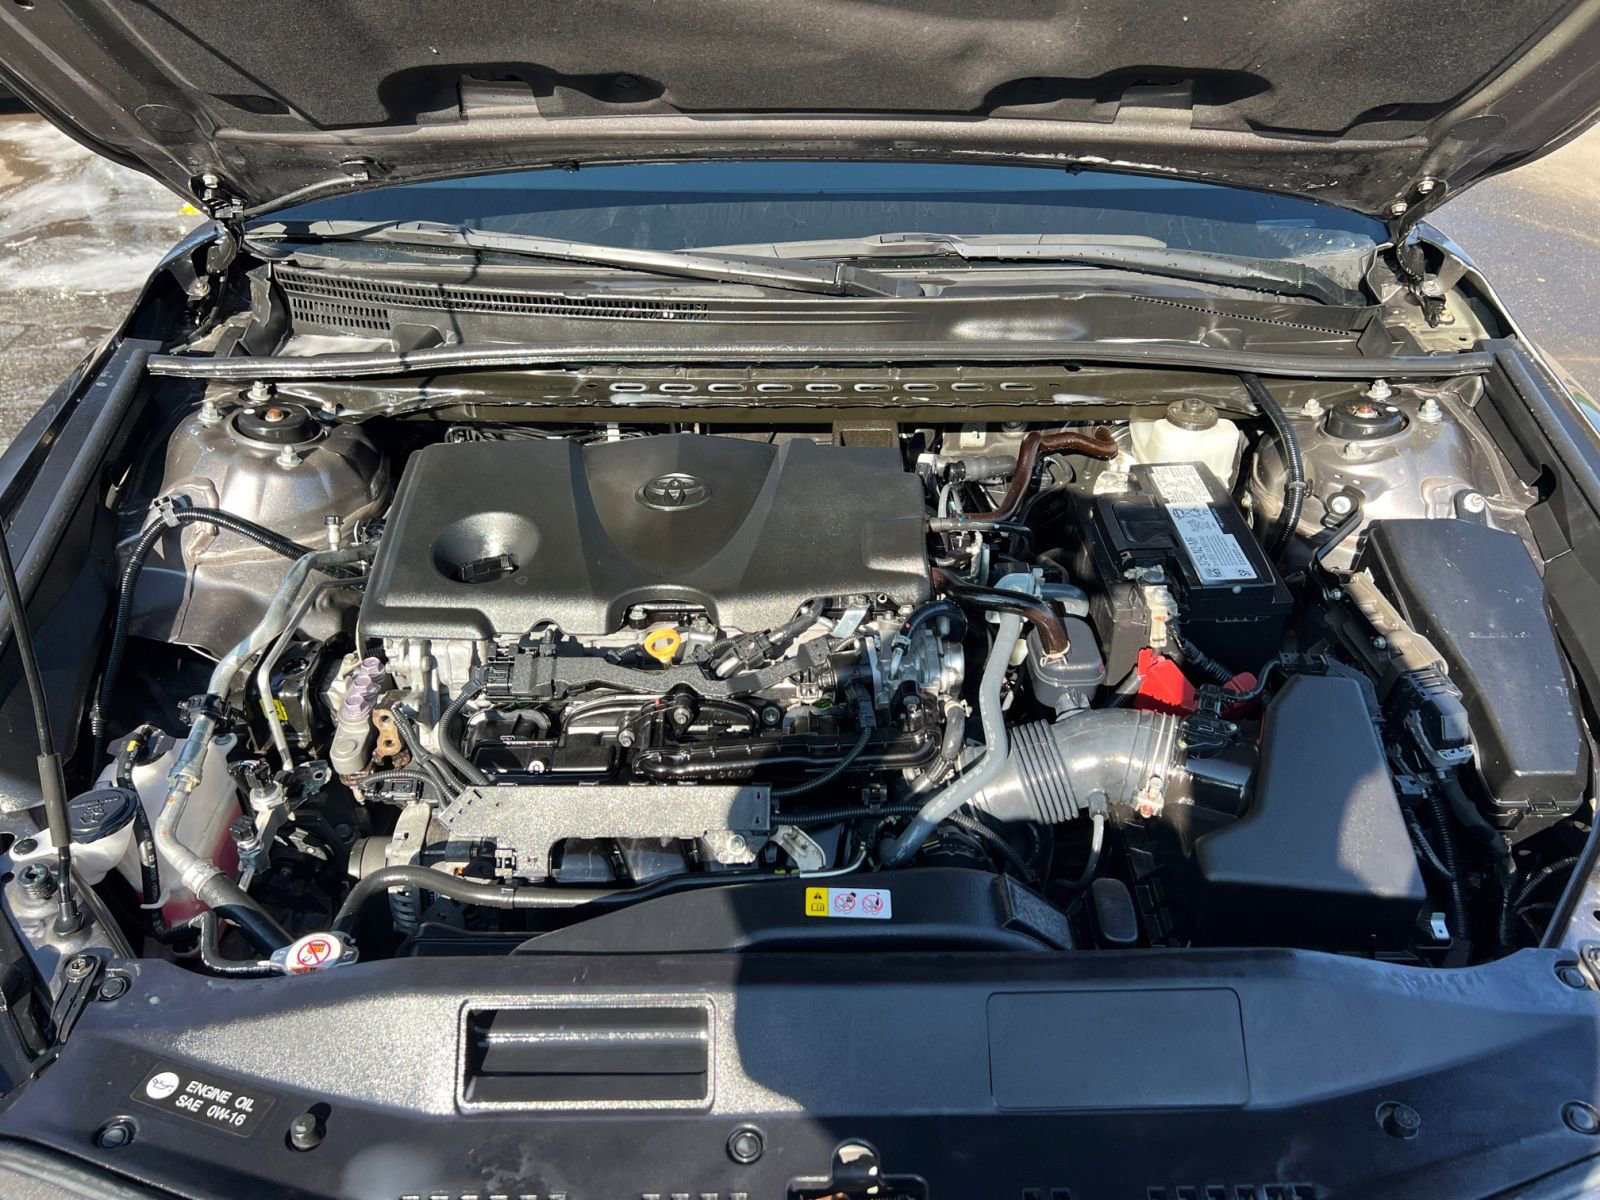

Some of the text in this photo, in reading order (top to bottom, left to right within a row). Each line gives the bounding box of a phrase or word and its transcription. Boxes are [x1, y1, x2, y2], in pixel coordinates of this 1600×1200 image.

[175, 1094, 247, 1126] SAE 0W-16
[185, 1080, 255, 1112] ENGINE OIL
